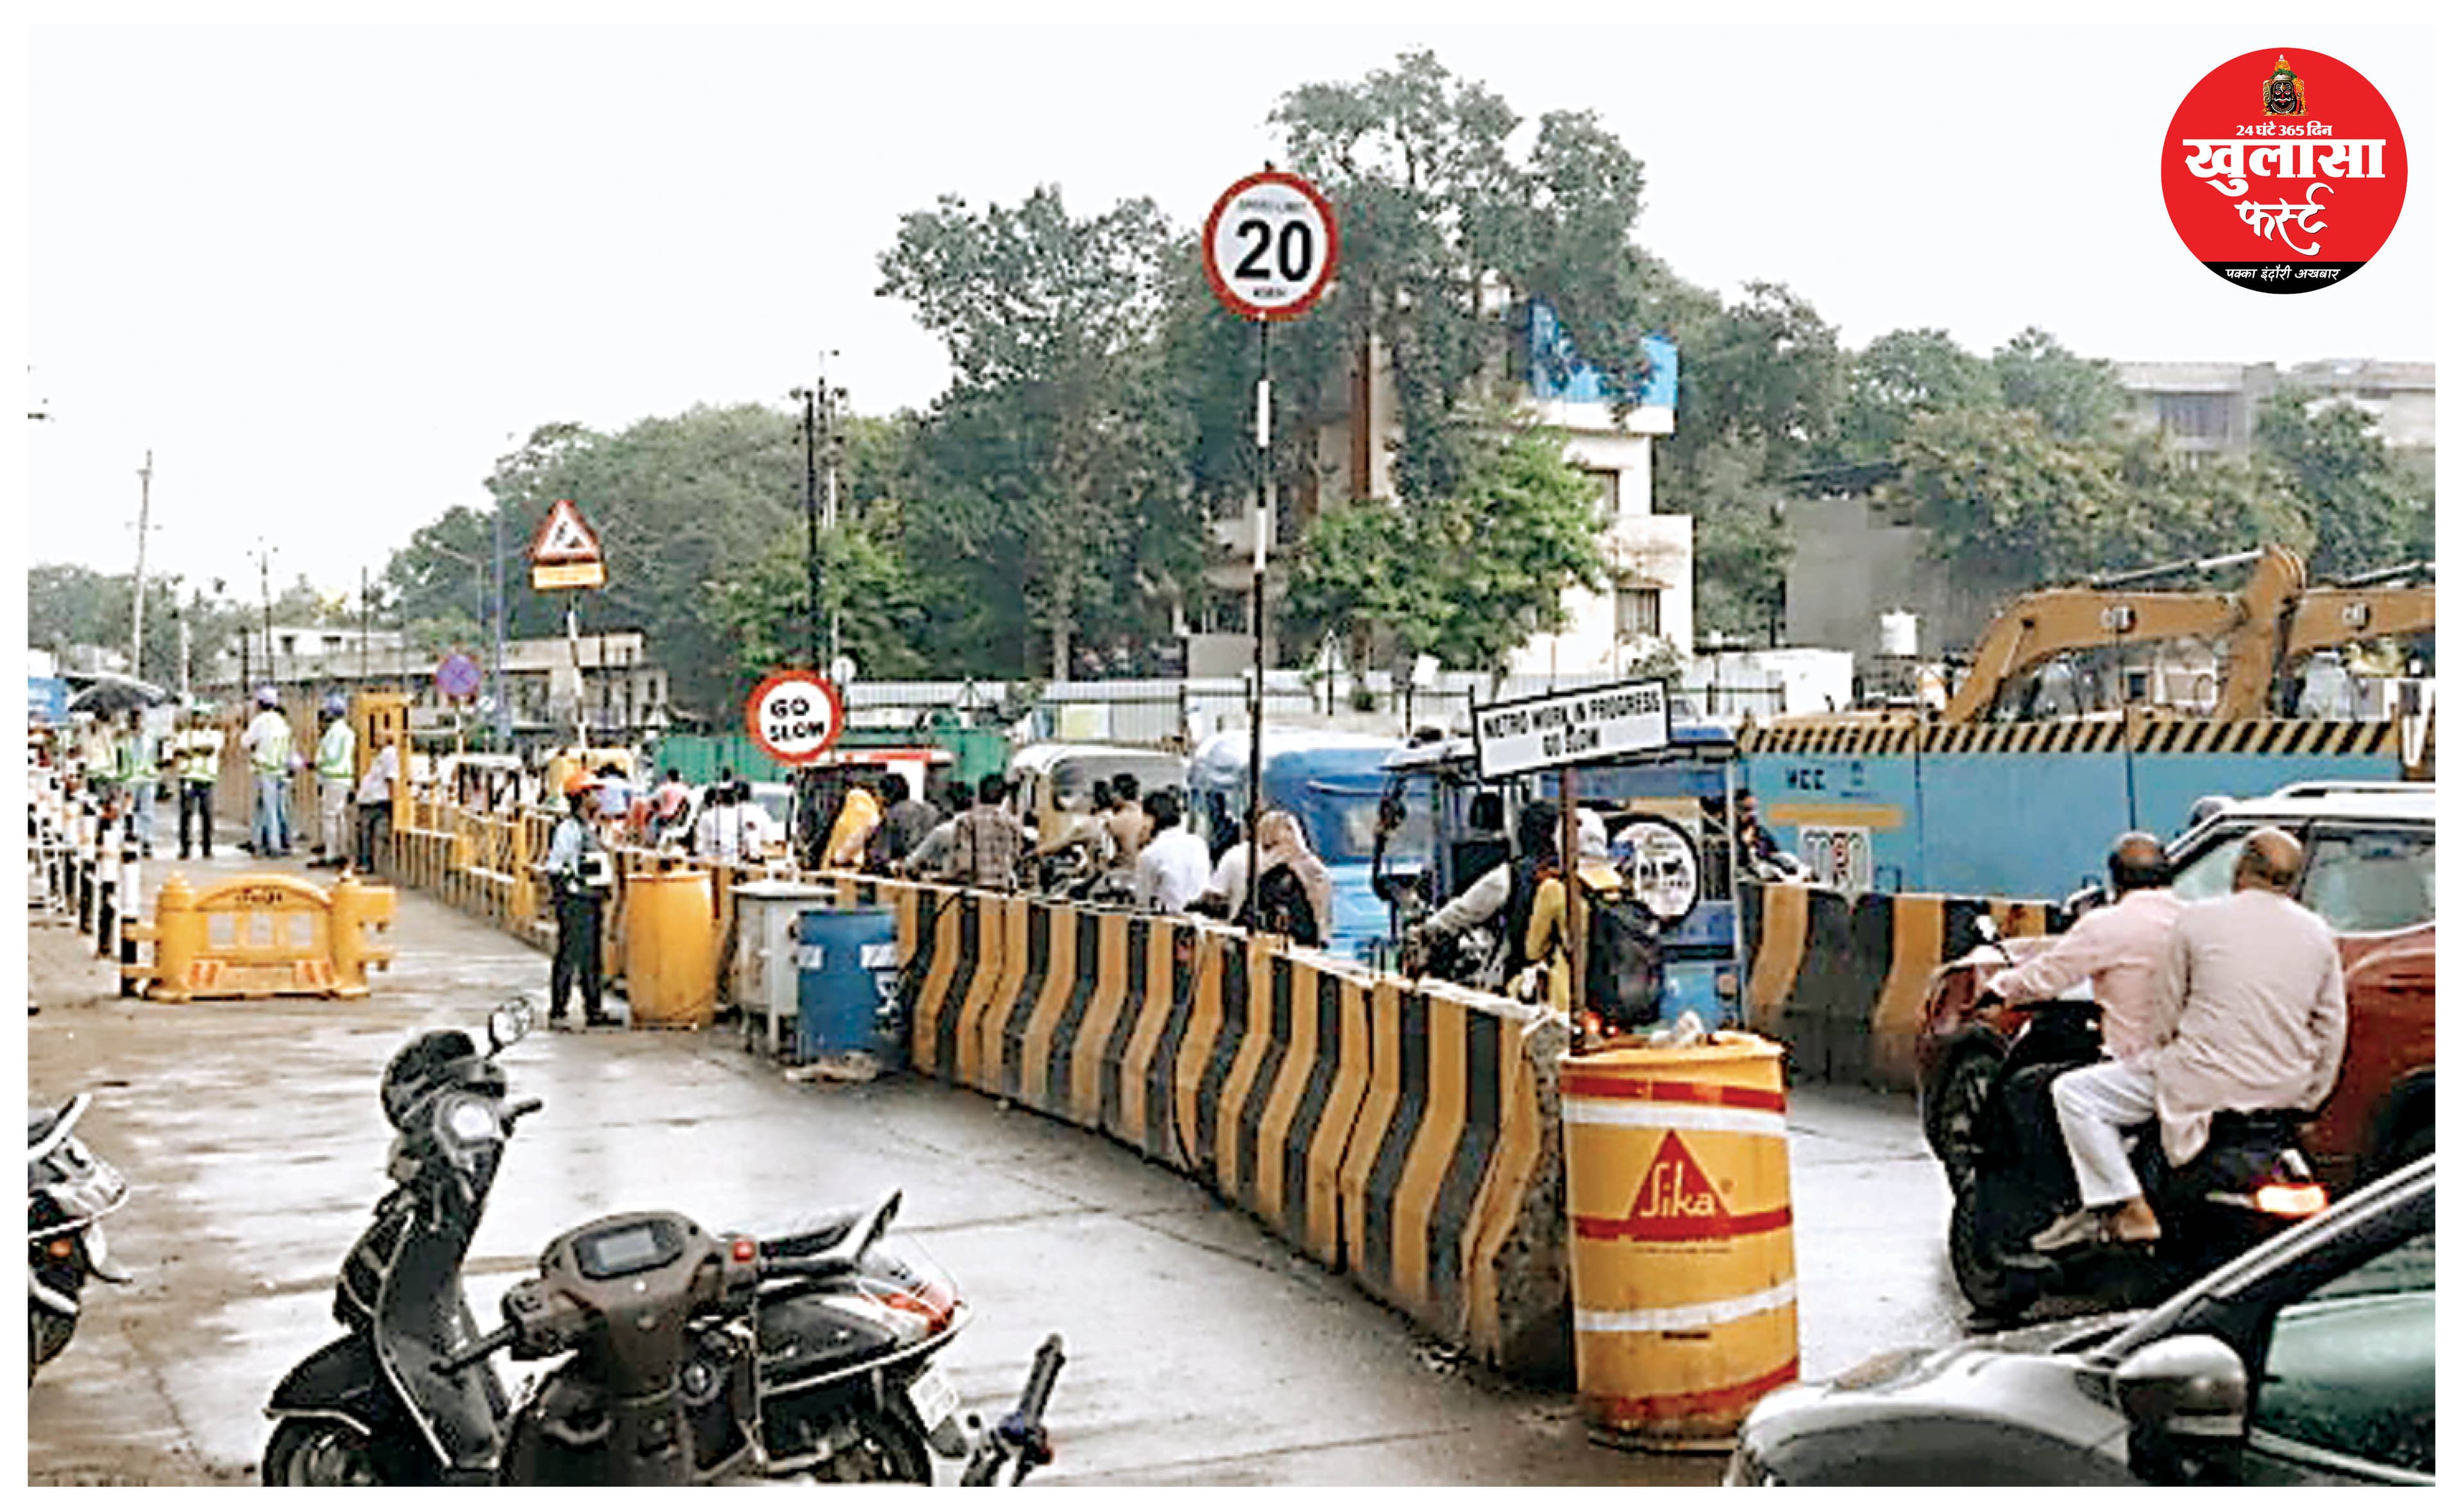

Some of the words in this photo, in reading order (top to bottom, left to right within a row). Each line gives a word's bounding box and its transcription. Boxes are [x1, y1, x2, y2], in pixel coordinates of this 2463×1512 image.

[1234, 219, 1312, 282] 20
[770, 696, 810, 719] GO
[1639, 1160, 1714, 1217] Sika
